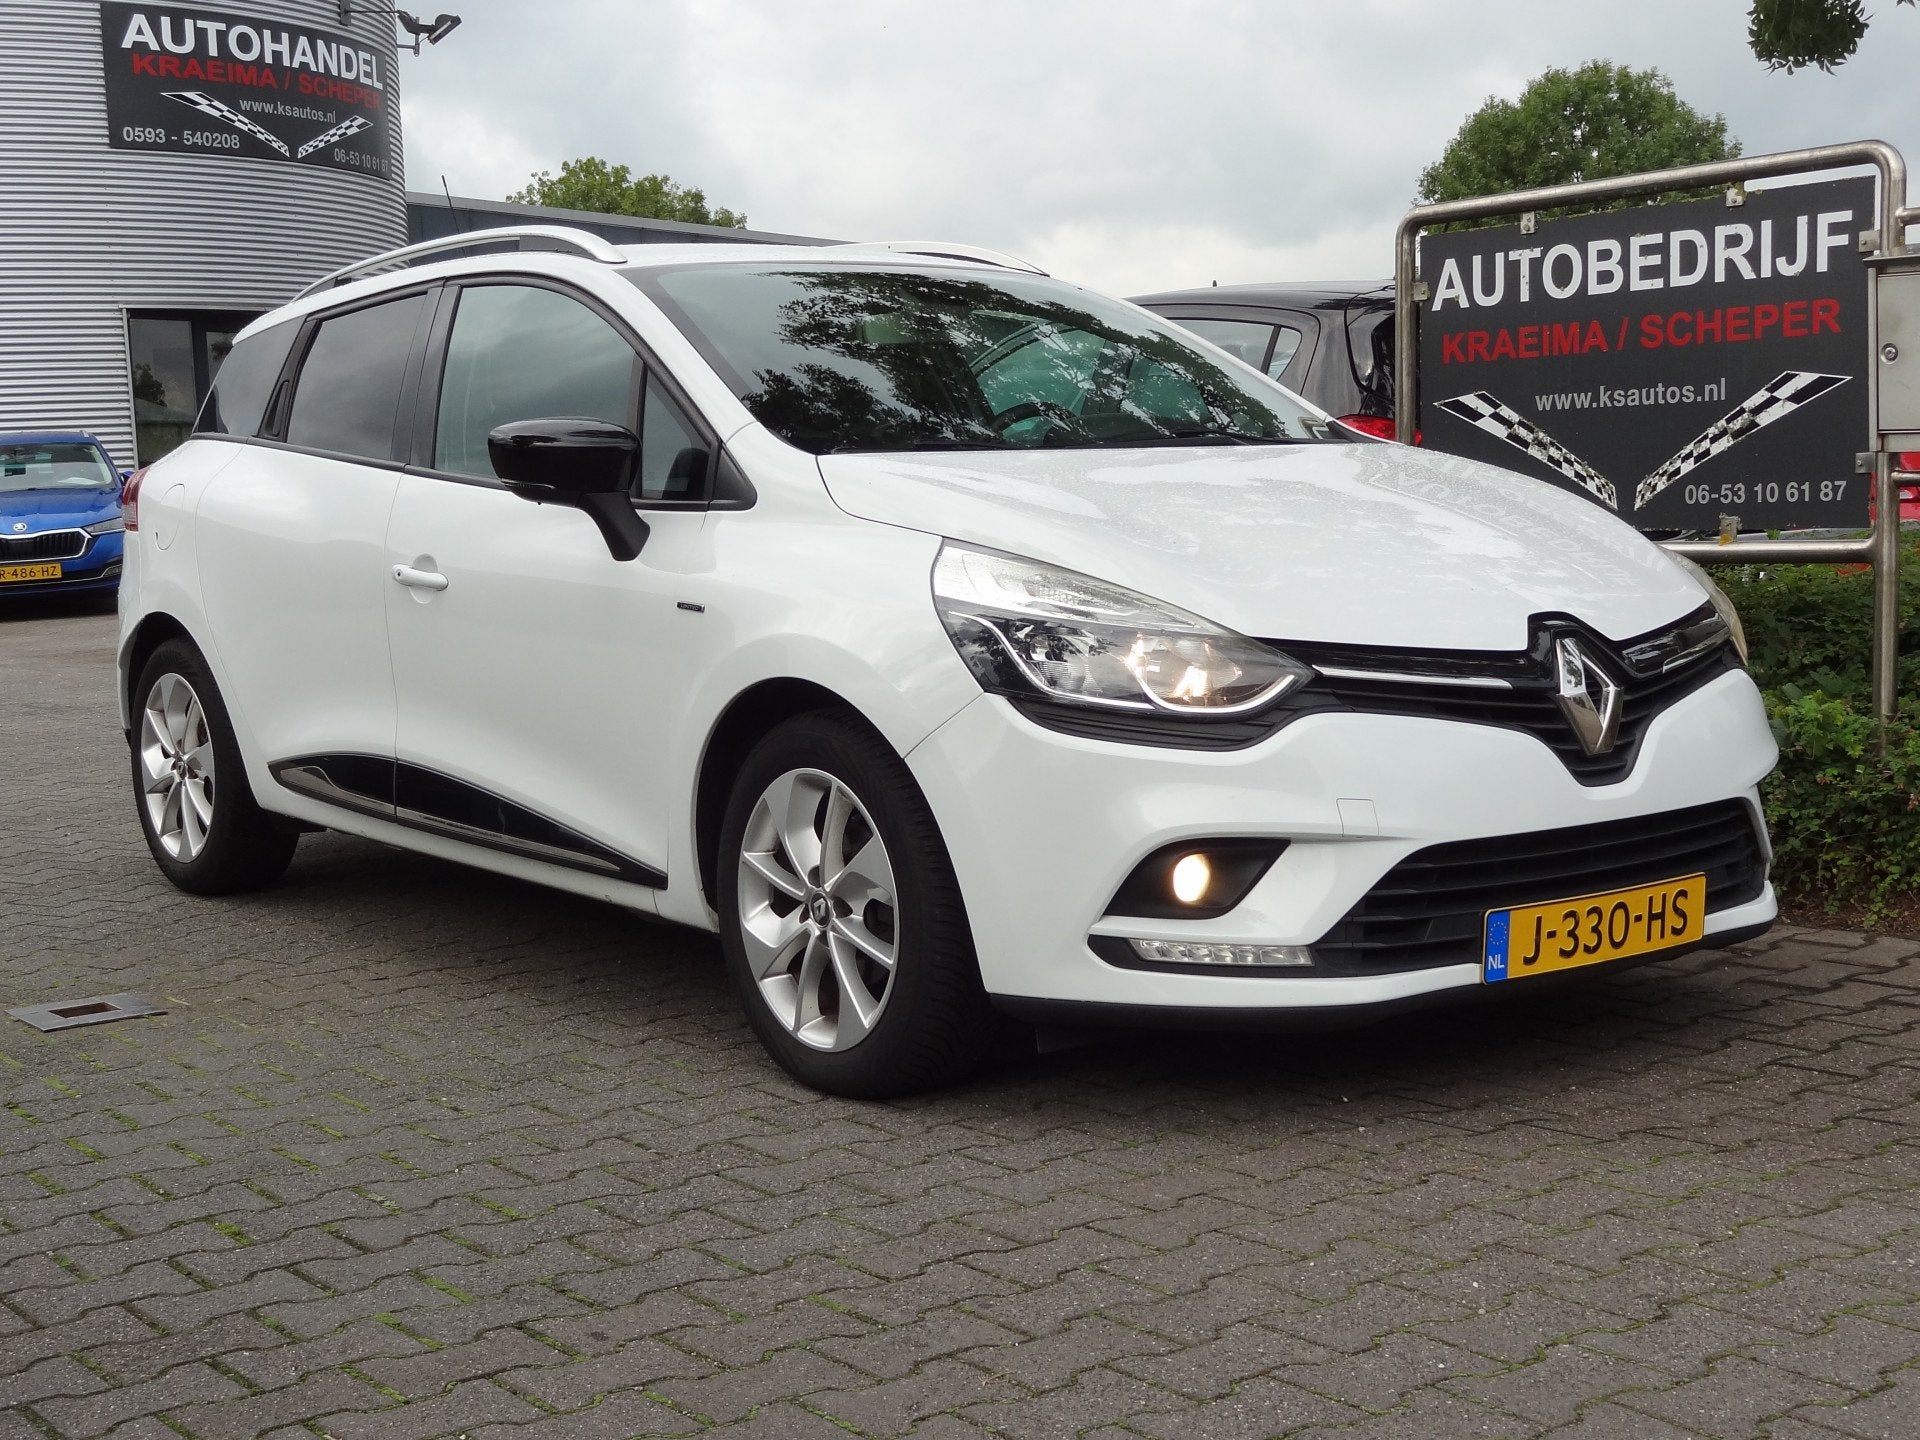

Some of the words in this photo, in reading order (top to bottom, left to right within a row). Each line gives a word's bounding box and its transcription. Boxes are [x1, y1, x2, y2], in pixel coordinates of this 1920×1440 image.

[121, 13, 383, 90] AUTOHANDEL
[132, 53, 278, 90] KRAEIMA
[284, 70, 291, 90] /
[298, 74, 381, 110] SCHEPER
[240, 99, 337, 124] www.ksautos.nl
[122, 126, 166, 143] 0593
[183, 130, 240, 149] 540208
[334, 147, 360, 166] 06-53
[361, 153, 371, 168] 10
[372, 156, 380, 170] 61
[1432, 210, 1853, 312] AUTOBEDRIJF
[1442, 320, 1608, 364] KRAEIMA
[1617, 317, 1629, 350] /
[1640, 298, 1841, 349] SCHEPER
[1535, 378, 1726, 411] www.ksautos.nl
[1684, 484, 1746, 505] 06-53
[1754, 482, 1779, 503] 10
[1785, 482, 1811, 502] 61
[1820, 480, 1847, 502] 87
[0, 566, 58, 579] R-486-HZ
[1522, 888, 1689, 966] J-330-HS
[1488, 954, 1505, 970] NL
